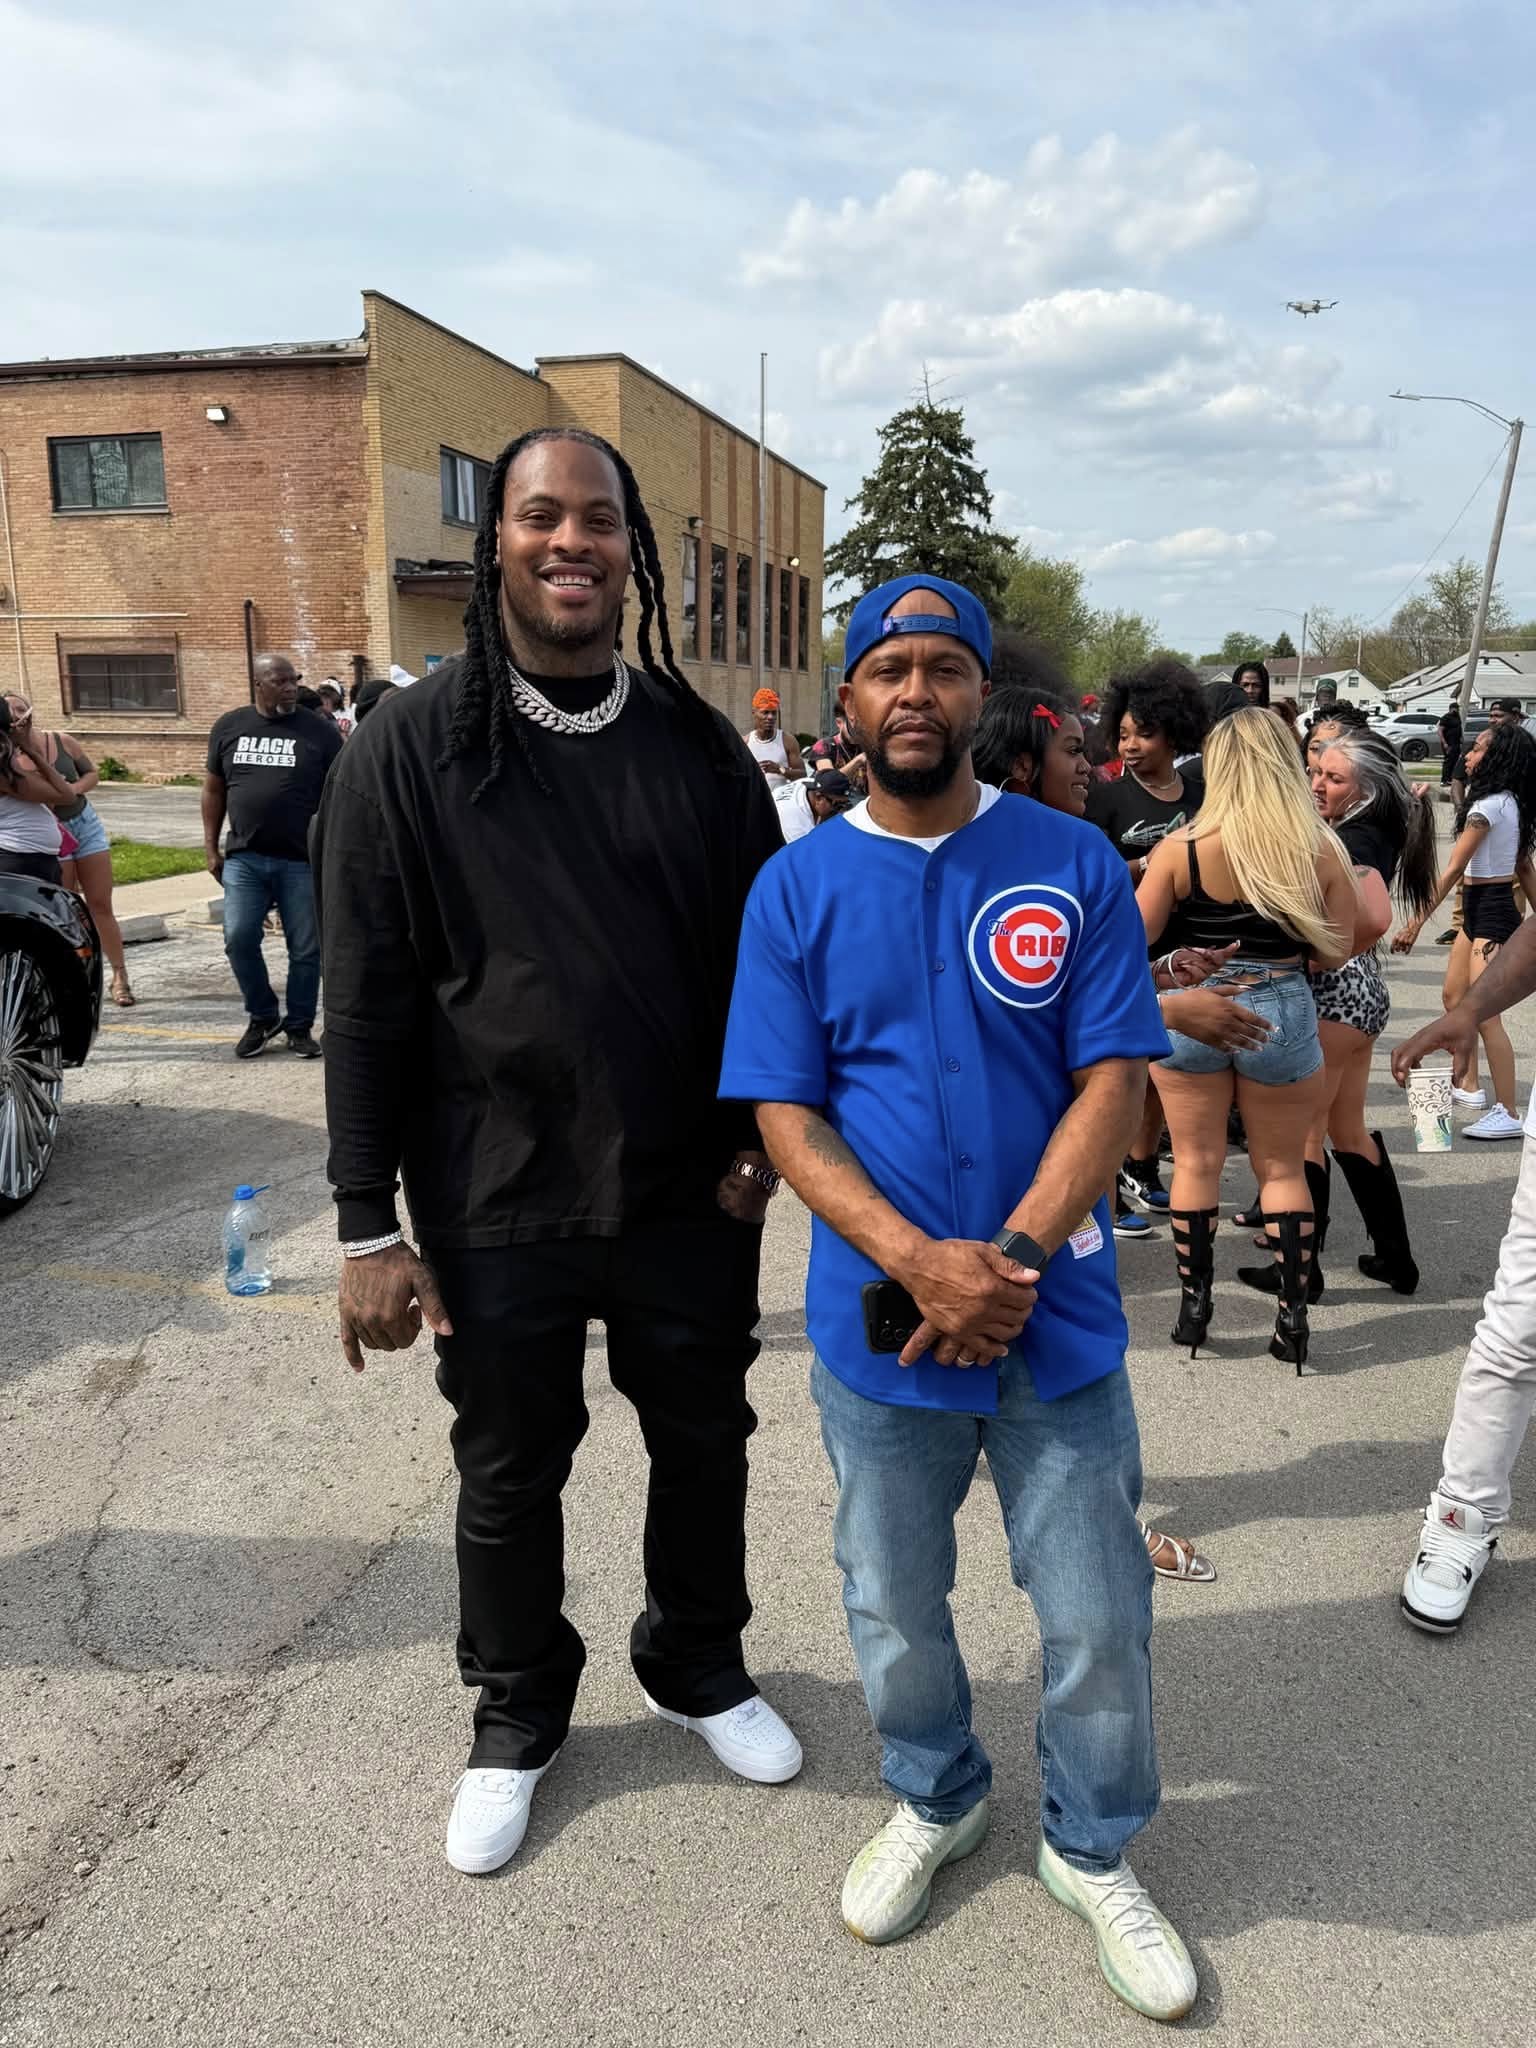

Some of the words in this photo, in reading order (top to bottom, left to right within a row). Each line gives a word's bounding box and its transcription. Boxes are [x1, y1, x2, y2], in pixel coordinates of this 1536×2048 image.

[237, 736, 296, 755] BLACK
[235, 754, 294, 765] HEROES
[986, 919, 1010, 936] The
